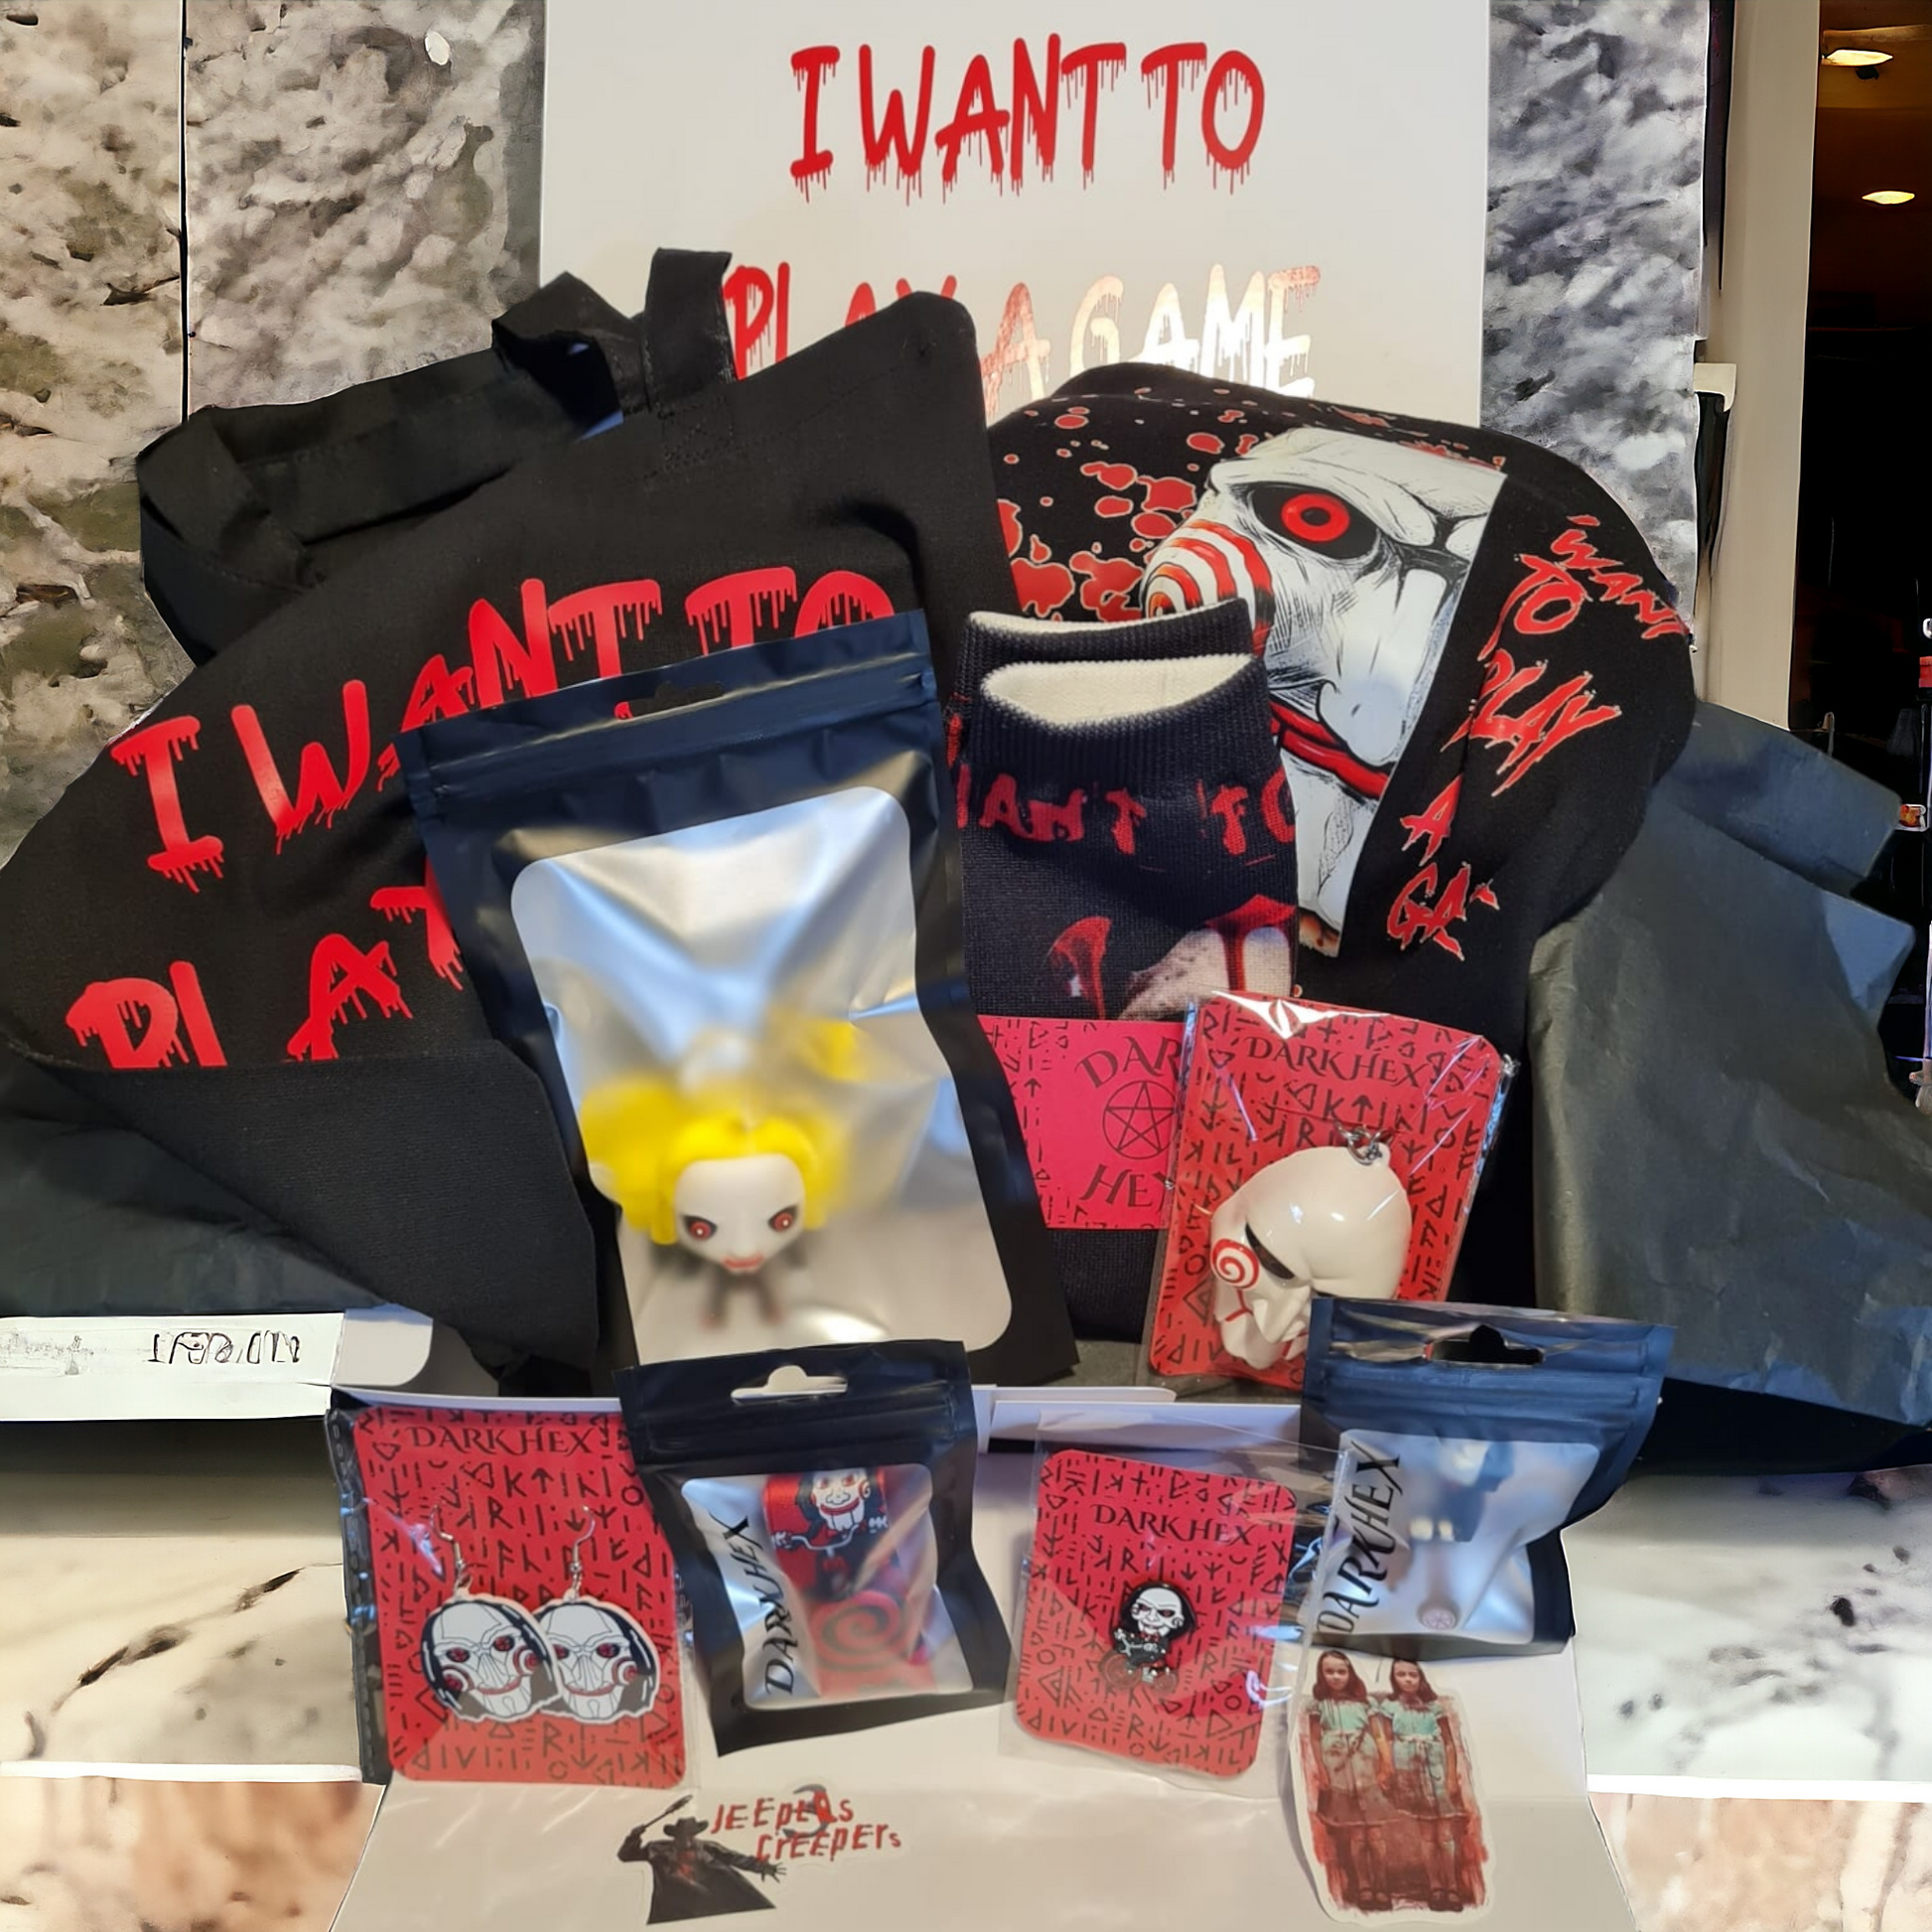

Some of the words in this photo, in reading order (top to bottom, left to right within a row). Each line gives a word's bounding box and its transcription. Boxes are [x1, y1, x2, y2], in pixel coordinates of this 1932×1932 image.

[790, 46, 840, 204] I
[859, 34, 1126, 206] WANT
[1142, 43, 1264, 194] TO
[723, 262, 957, 380] PL
[980, 282, 1050, 417] A
[1070, 263, 1320, 398] GAME
[1478, 552, 1592, 661] TO
[1441, 648, 1622, 796] PLAY
[109, 715, 224, 893] I
[956, 762, 1146, 855] ANT
[1400, 773, 1463, 866] A
[1074, 1035, 1183, 1089] DAR
